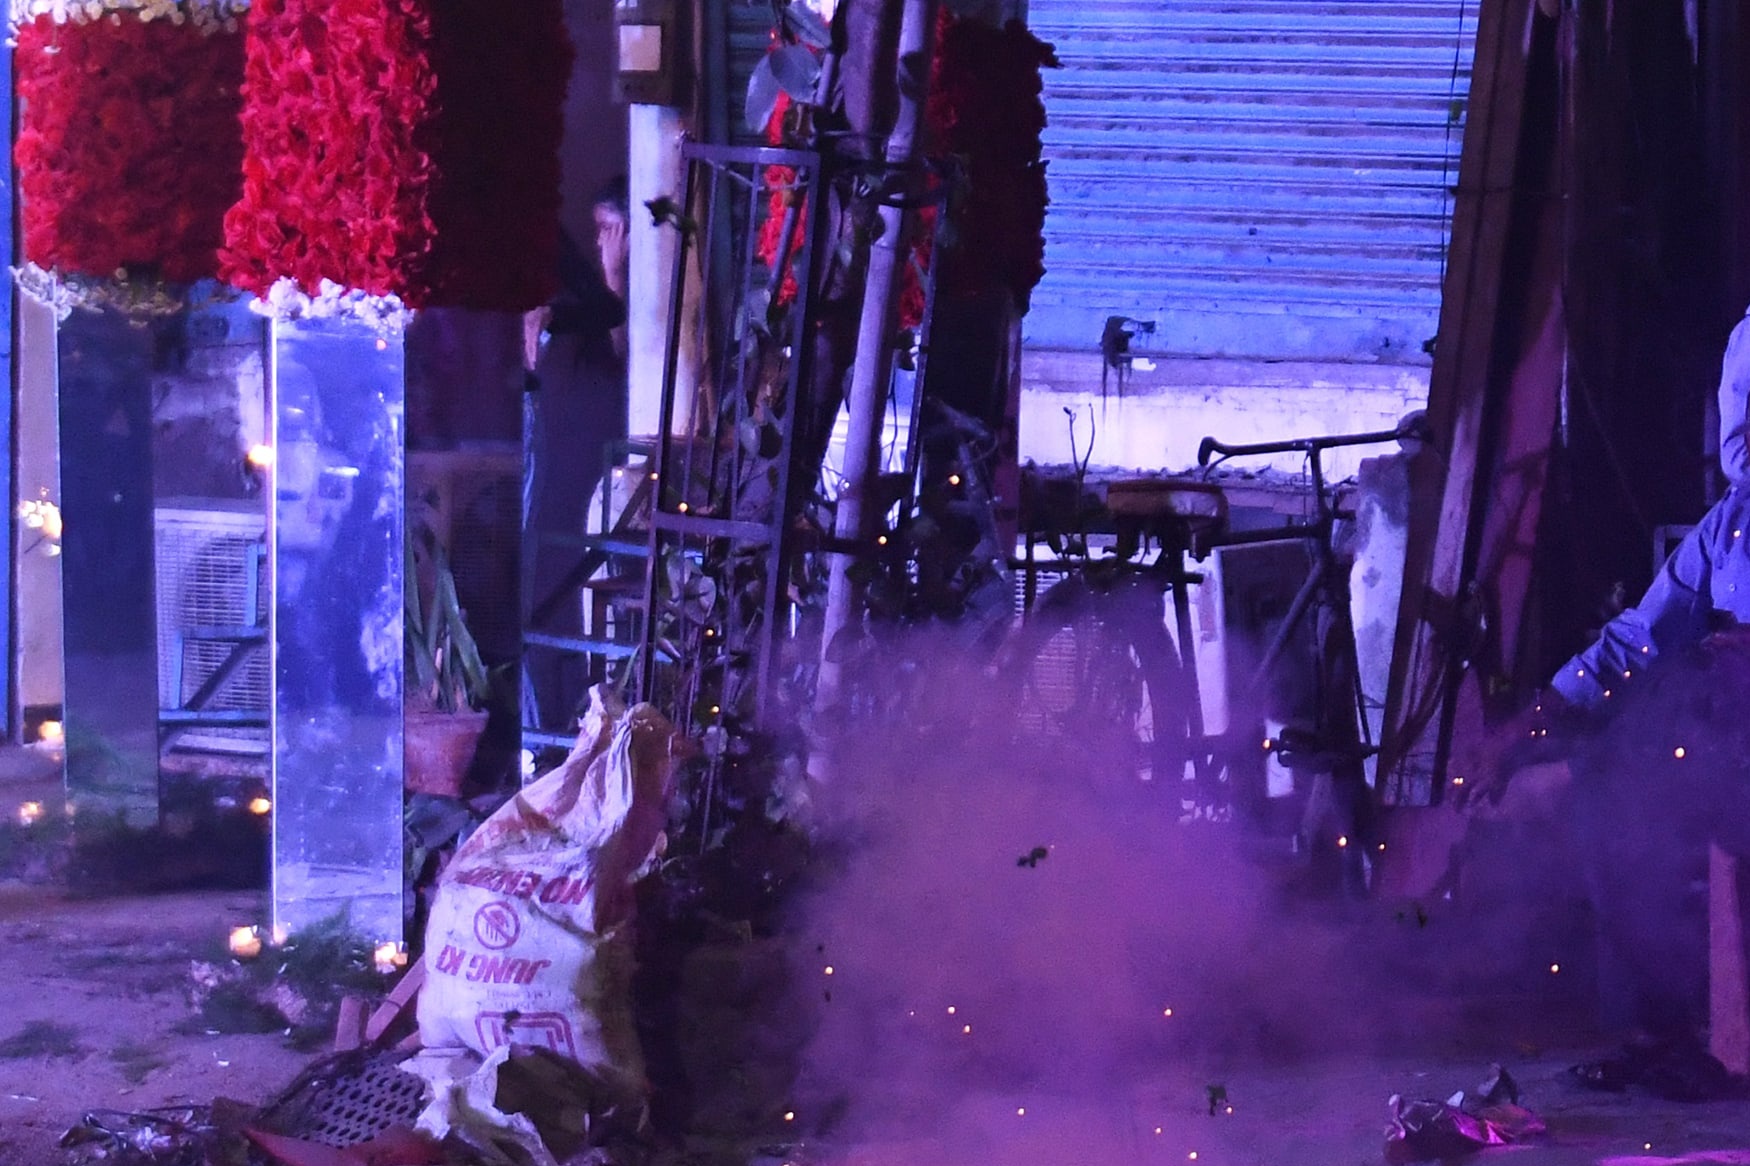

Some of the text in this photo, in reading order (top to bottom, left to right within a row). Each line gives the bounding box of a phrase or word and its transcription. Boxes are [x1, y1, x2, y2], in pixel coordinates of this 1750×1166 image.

[540, 874, 596, 905] NO
[435, 945, 552, 984] JUNG KI
